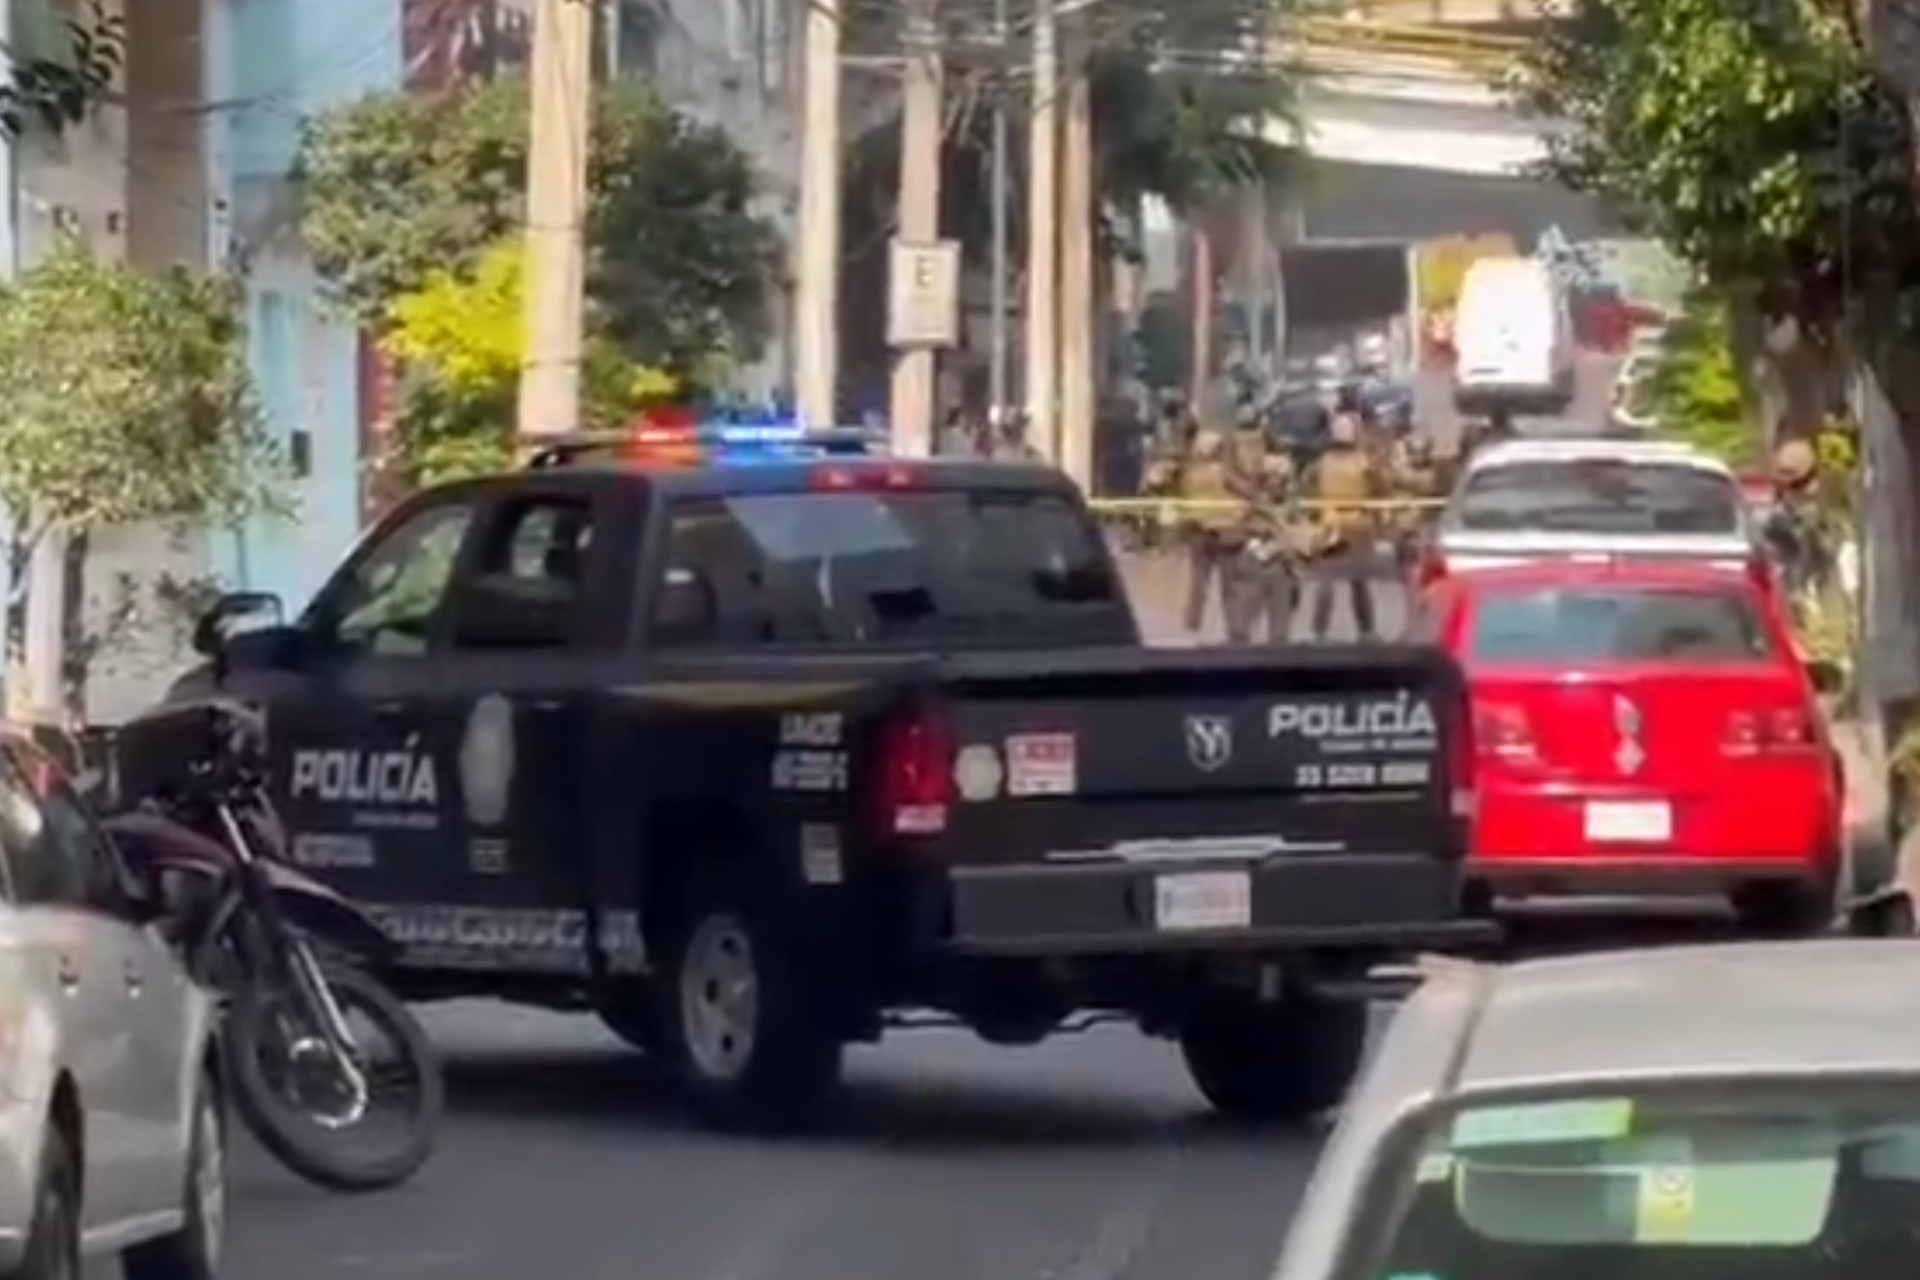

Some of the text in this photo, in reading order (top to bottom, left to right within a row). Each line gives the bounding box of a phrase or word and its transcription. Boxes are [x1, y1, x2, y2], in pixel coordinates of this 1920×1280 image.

[914, 254, 934, 290] E
[1268, 689, 1435, 736] POLICÍA
[291, 732, 437, 803] POLICÍA
